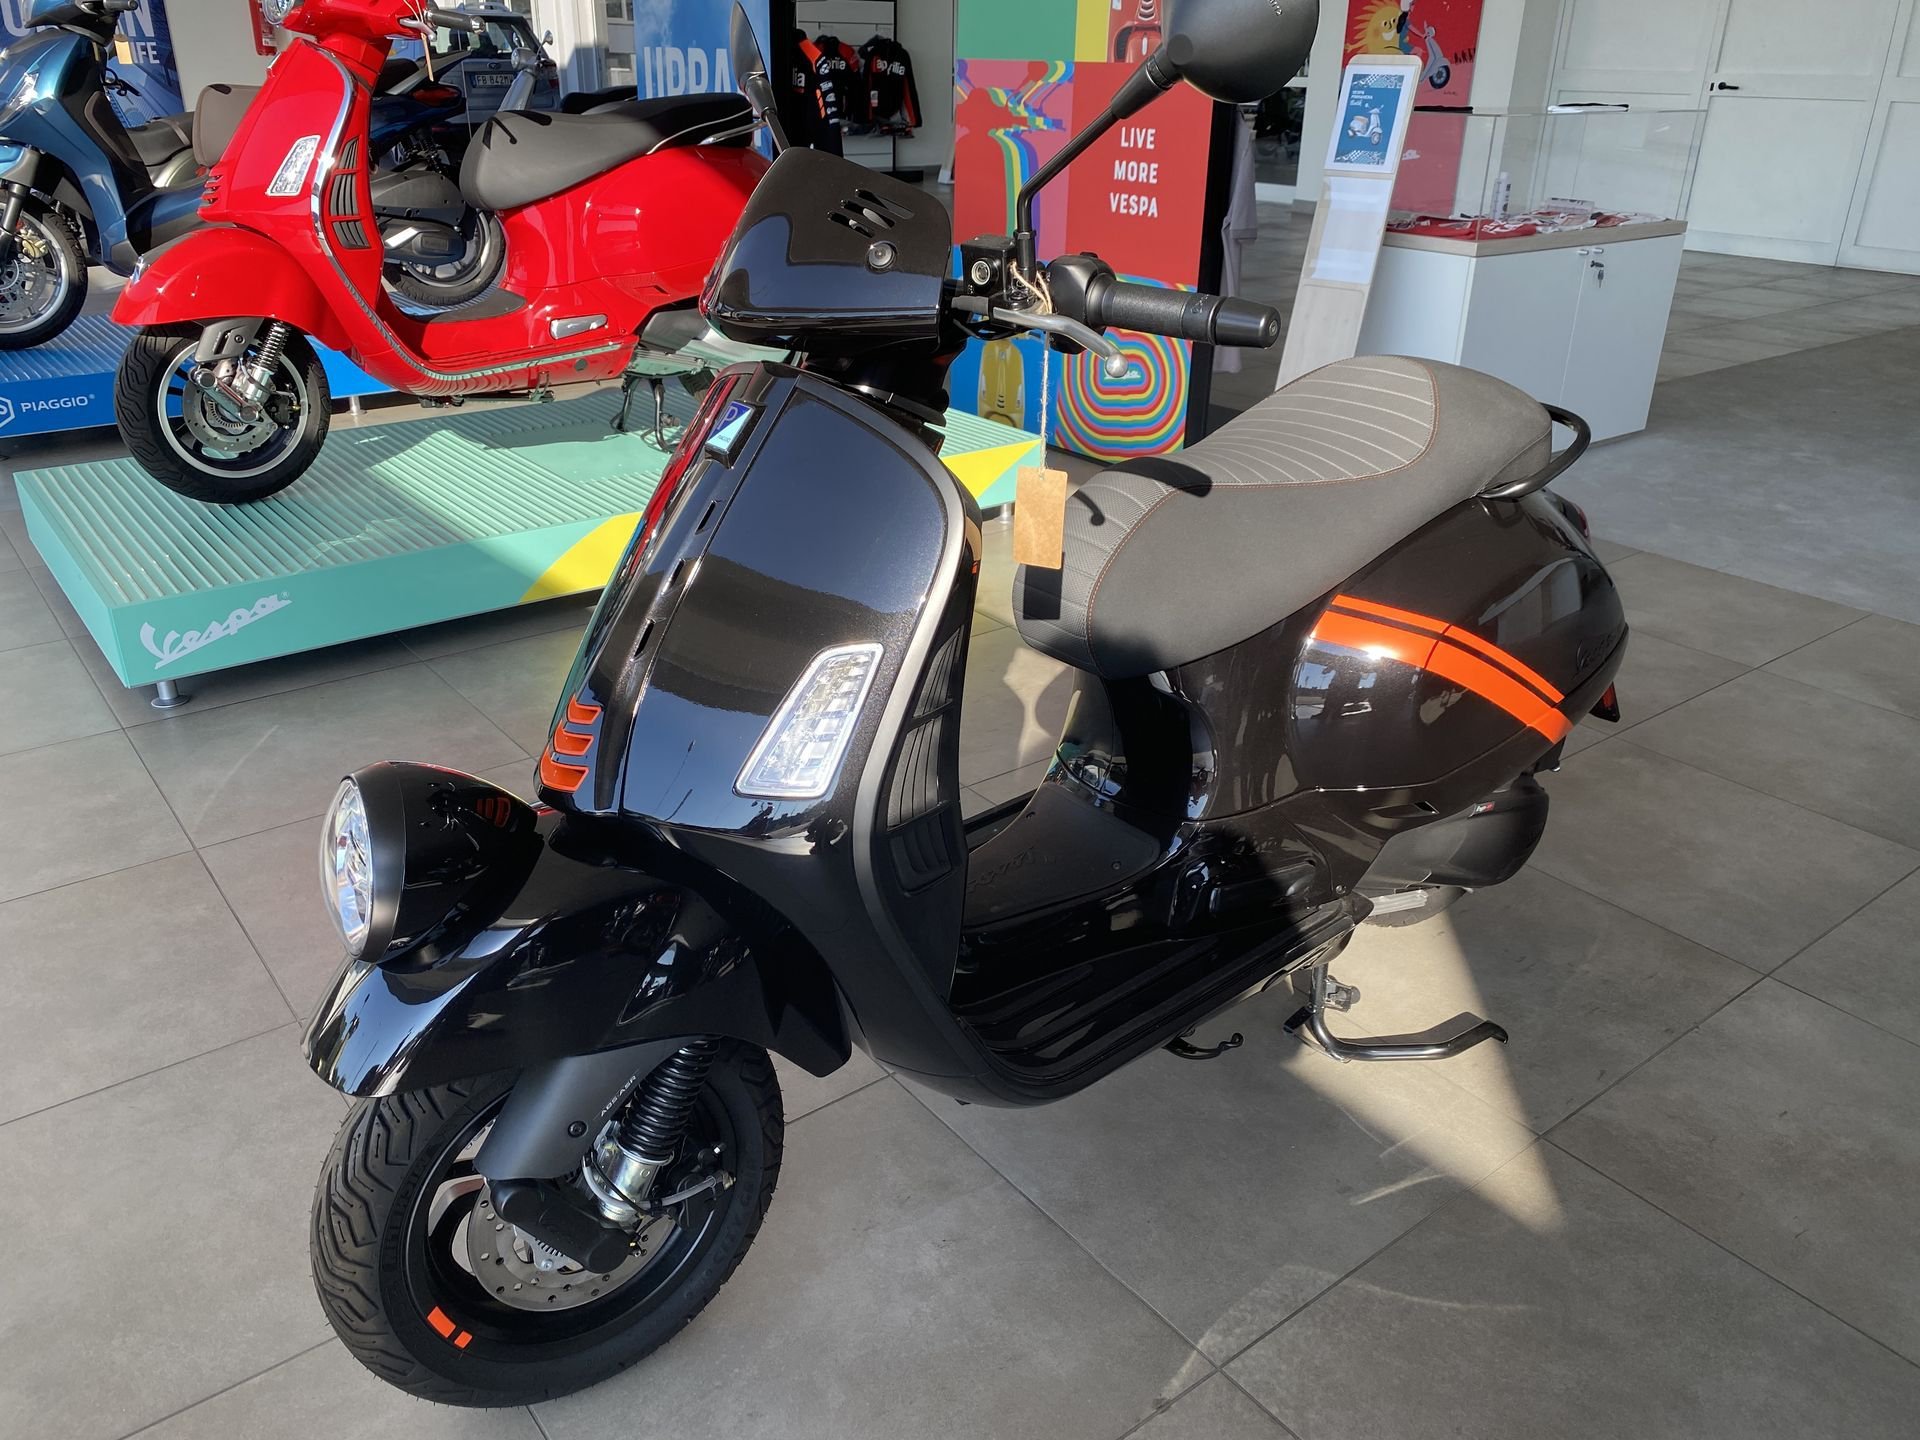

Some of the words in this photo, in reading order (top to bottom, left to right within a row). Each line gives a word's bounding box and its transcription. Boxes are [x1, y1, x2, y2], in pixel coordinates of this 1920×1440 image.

[131, 41, 160, 64] IFE
[1120, 126, 1156, 149] LIVE
[1113, 160, 1158, 184] MORE
[1109, 192, 1158, 218] VESPA
[20, 396, 88, 412] PIAGGIO
[139, 594, 293, 670] Vespa
